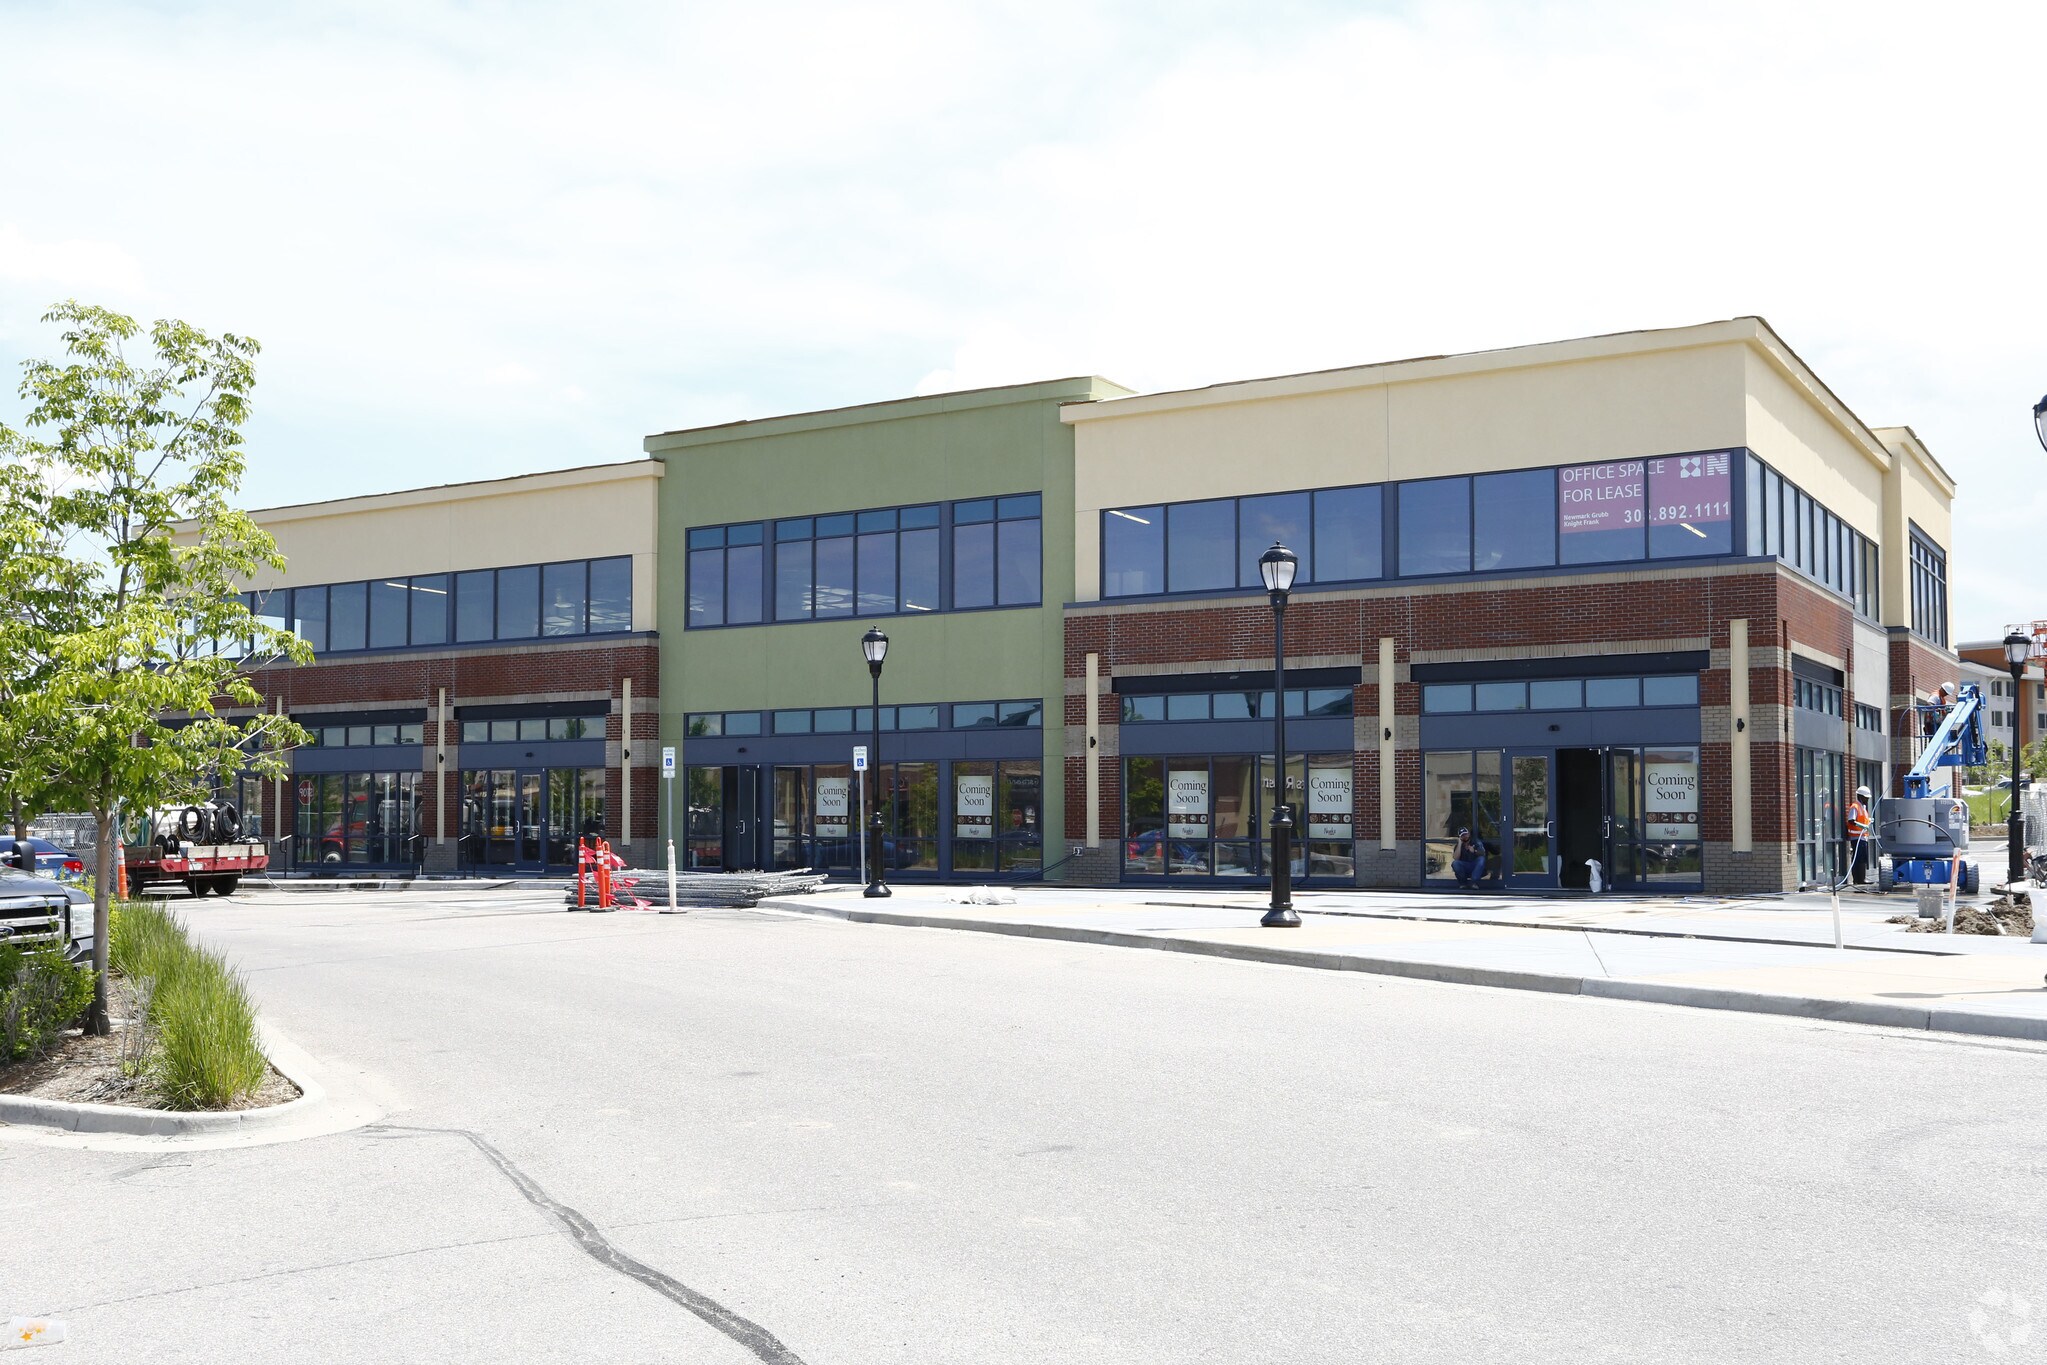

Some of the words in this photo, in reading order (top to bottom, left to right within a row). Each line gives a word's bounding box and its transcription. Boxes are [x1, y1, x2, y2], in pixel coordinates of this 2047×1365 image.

[1563, 465, 1615, 482] OFFICE
[1619, 460, 1665, 478] SPACE
[1563, 488, 1593, 503] FOR
[1597, 483, 1642, 500] LEASE
[1563, 513, 1591, 521] Newmark
[1591, 511, 1609, 519] Grubb
[1563, 520, 1583, 528] Knight
[1583, 518, 1600, 526] Frank
[1170, 778, 1207, 795] Coming
[1310, 776, 1350, 793] Coming
[1647, 772, 1695, 790] Coming
[818, 785, 846, 799] Coming
[959, 783, 991, 798] Coming
[1317, 790, 1342, 802] Soon
[1656, 786, 1686, 800] Soon
[822, 796, 841, 806] Soon
[964, 795, 985, 806] Soon
[1176, 792, 1200, 804] Soon
